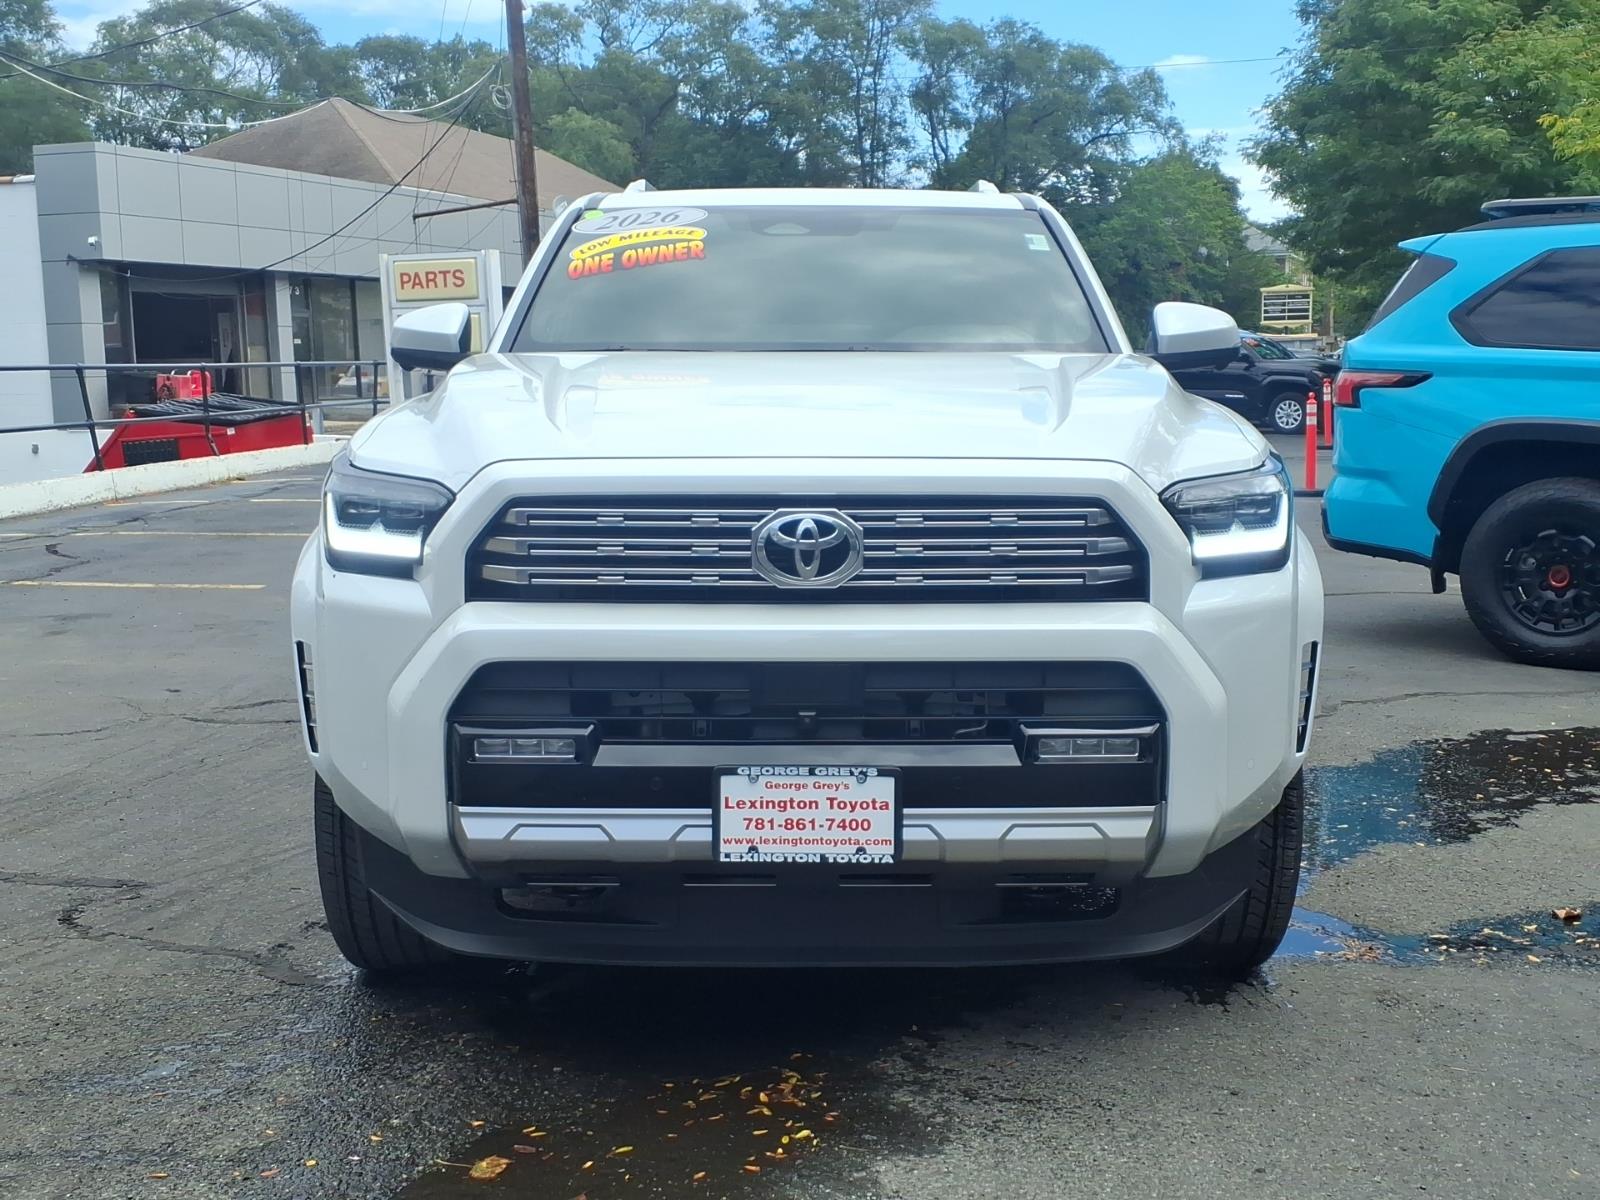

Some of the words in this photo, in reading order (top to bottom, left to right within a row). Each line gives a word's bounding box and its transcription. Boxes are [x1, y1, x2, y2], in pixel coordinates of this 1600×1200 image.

[595, 209, 682, 230] 2026
[579, 239, 612, 254] LOW
[618, 228, 696, 242] MILEAGE
[567, 252, 614, 280] ONE
[621, 240, 706, 269] OWNER
[399, 269, 466, 290] PARTS
[737, 766, 809, 776] GEORGE
[815, 767, 878, 776] GREY'S
[764, 781, 809, 791] George
[812, 781, 850, 791] Grey's
[724, 796, 819, 812] Lexington
[826, 797, 890, 812] Toyota
[743, 817, 872, 831] 781-861-7400
[722, 836, 892, 847] www.lexingtontoyota.com
[720, 853, 821, 862] LEXINGTON
[825, 853, 894, 863] TOYOTA
